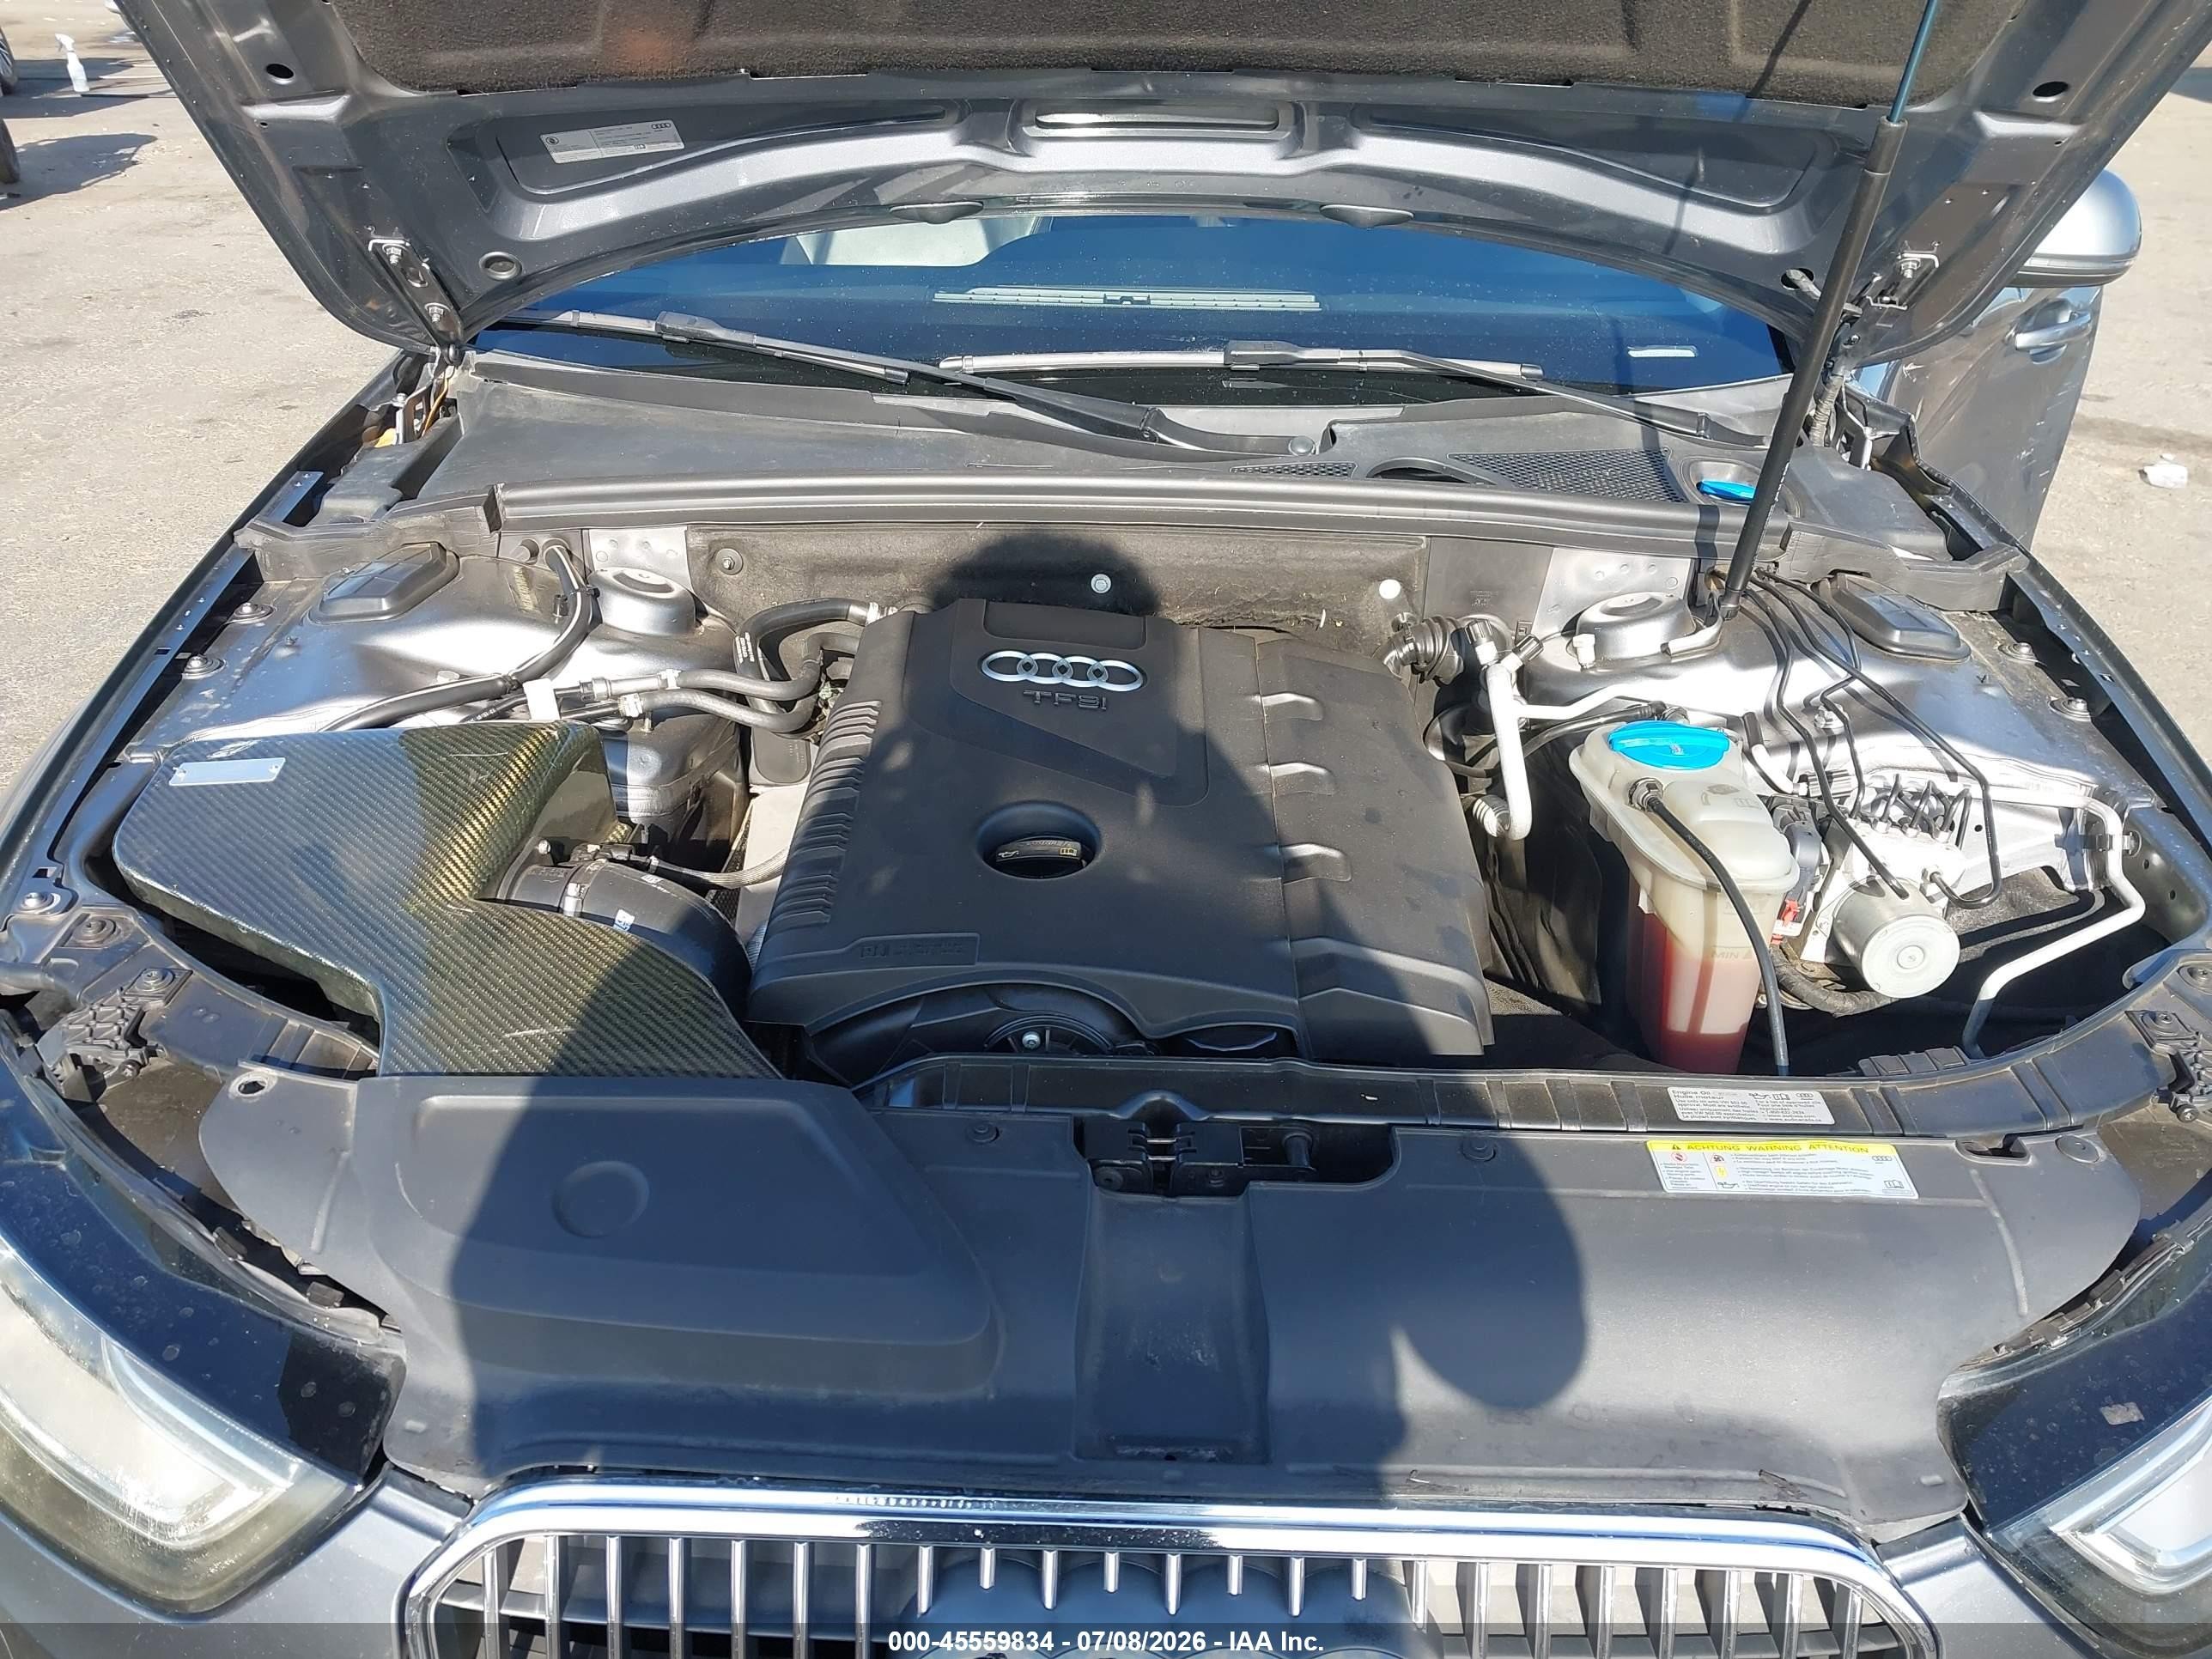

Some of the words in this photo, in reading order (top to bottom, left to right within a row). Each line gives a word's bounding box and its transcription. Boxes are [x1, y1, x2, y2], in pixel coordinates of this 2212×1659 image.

[1023, 690, 1107, 710] TFSI
[1686, 1143, 1741, 1152] ACHTUNG
[1808, 1144, 1869, 1153] ATTENTION
